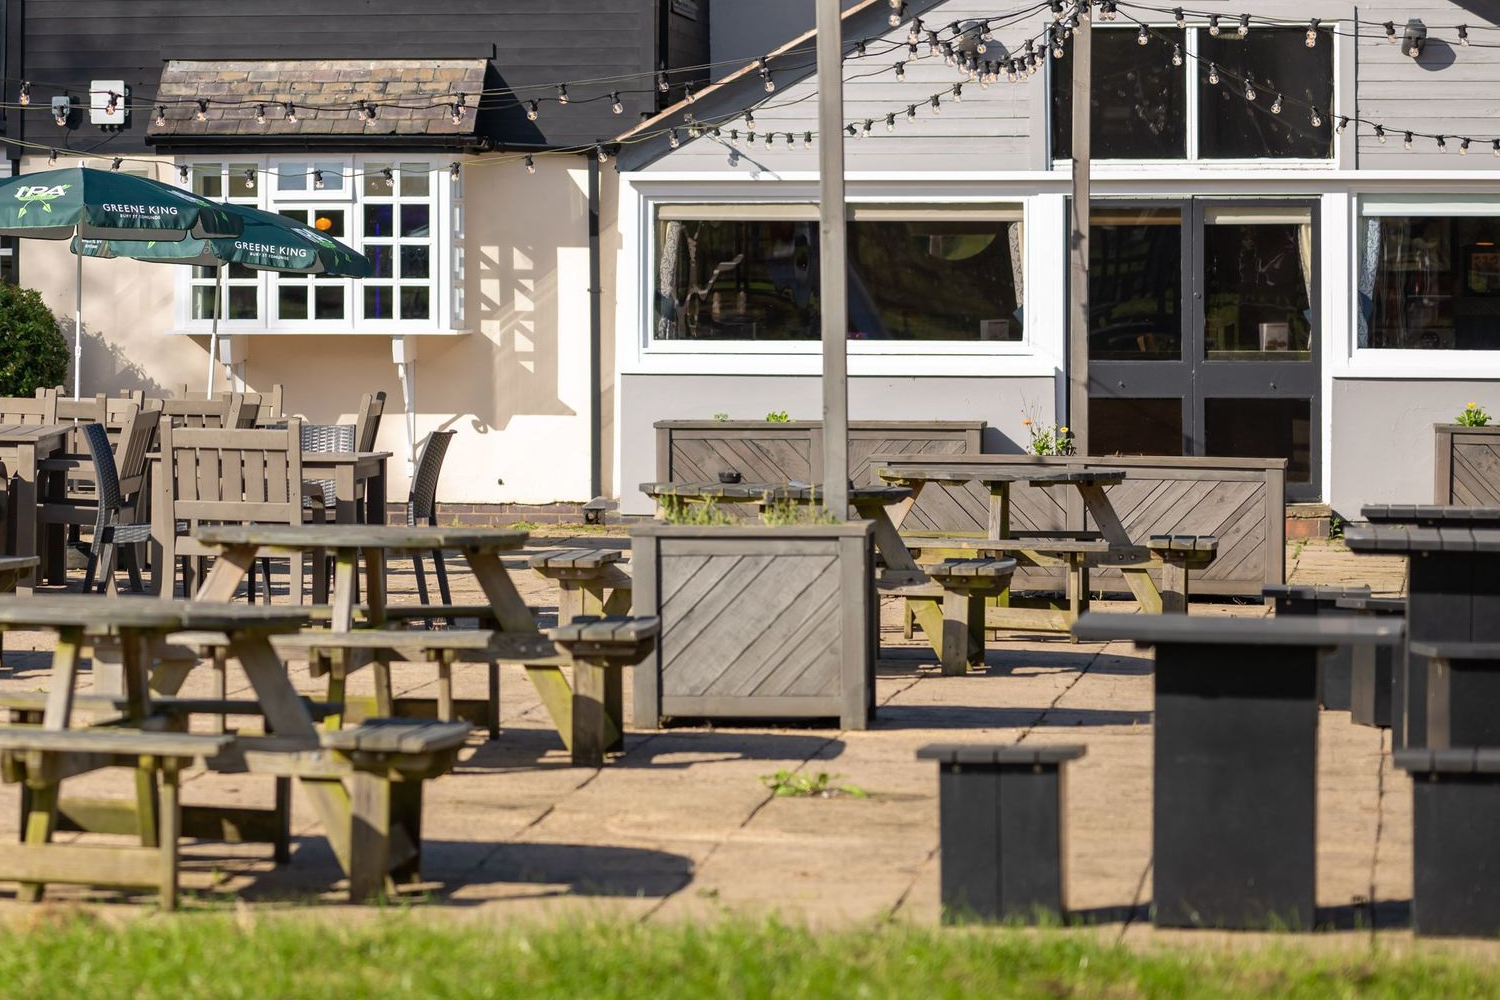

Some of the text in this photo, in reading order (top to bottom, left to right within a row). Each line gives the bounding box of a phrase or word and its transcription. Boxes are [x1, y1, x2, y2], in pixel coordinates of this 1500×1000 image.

[15, 185, 66, 199] IPA
[102, 203, 178, 215] GREENE KING
[234, 241, 307, 258] GREENE KING
